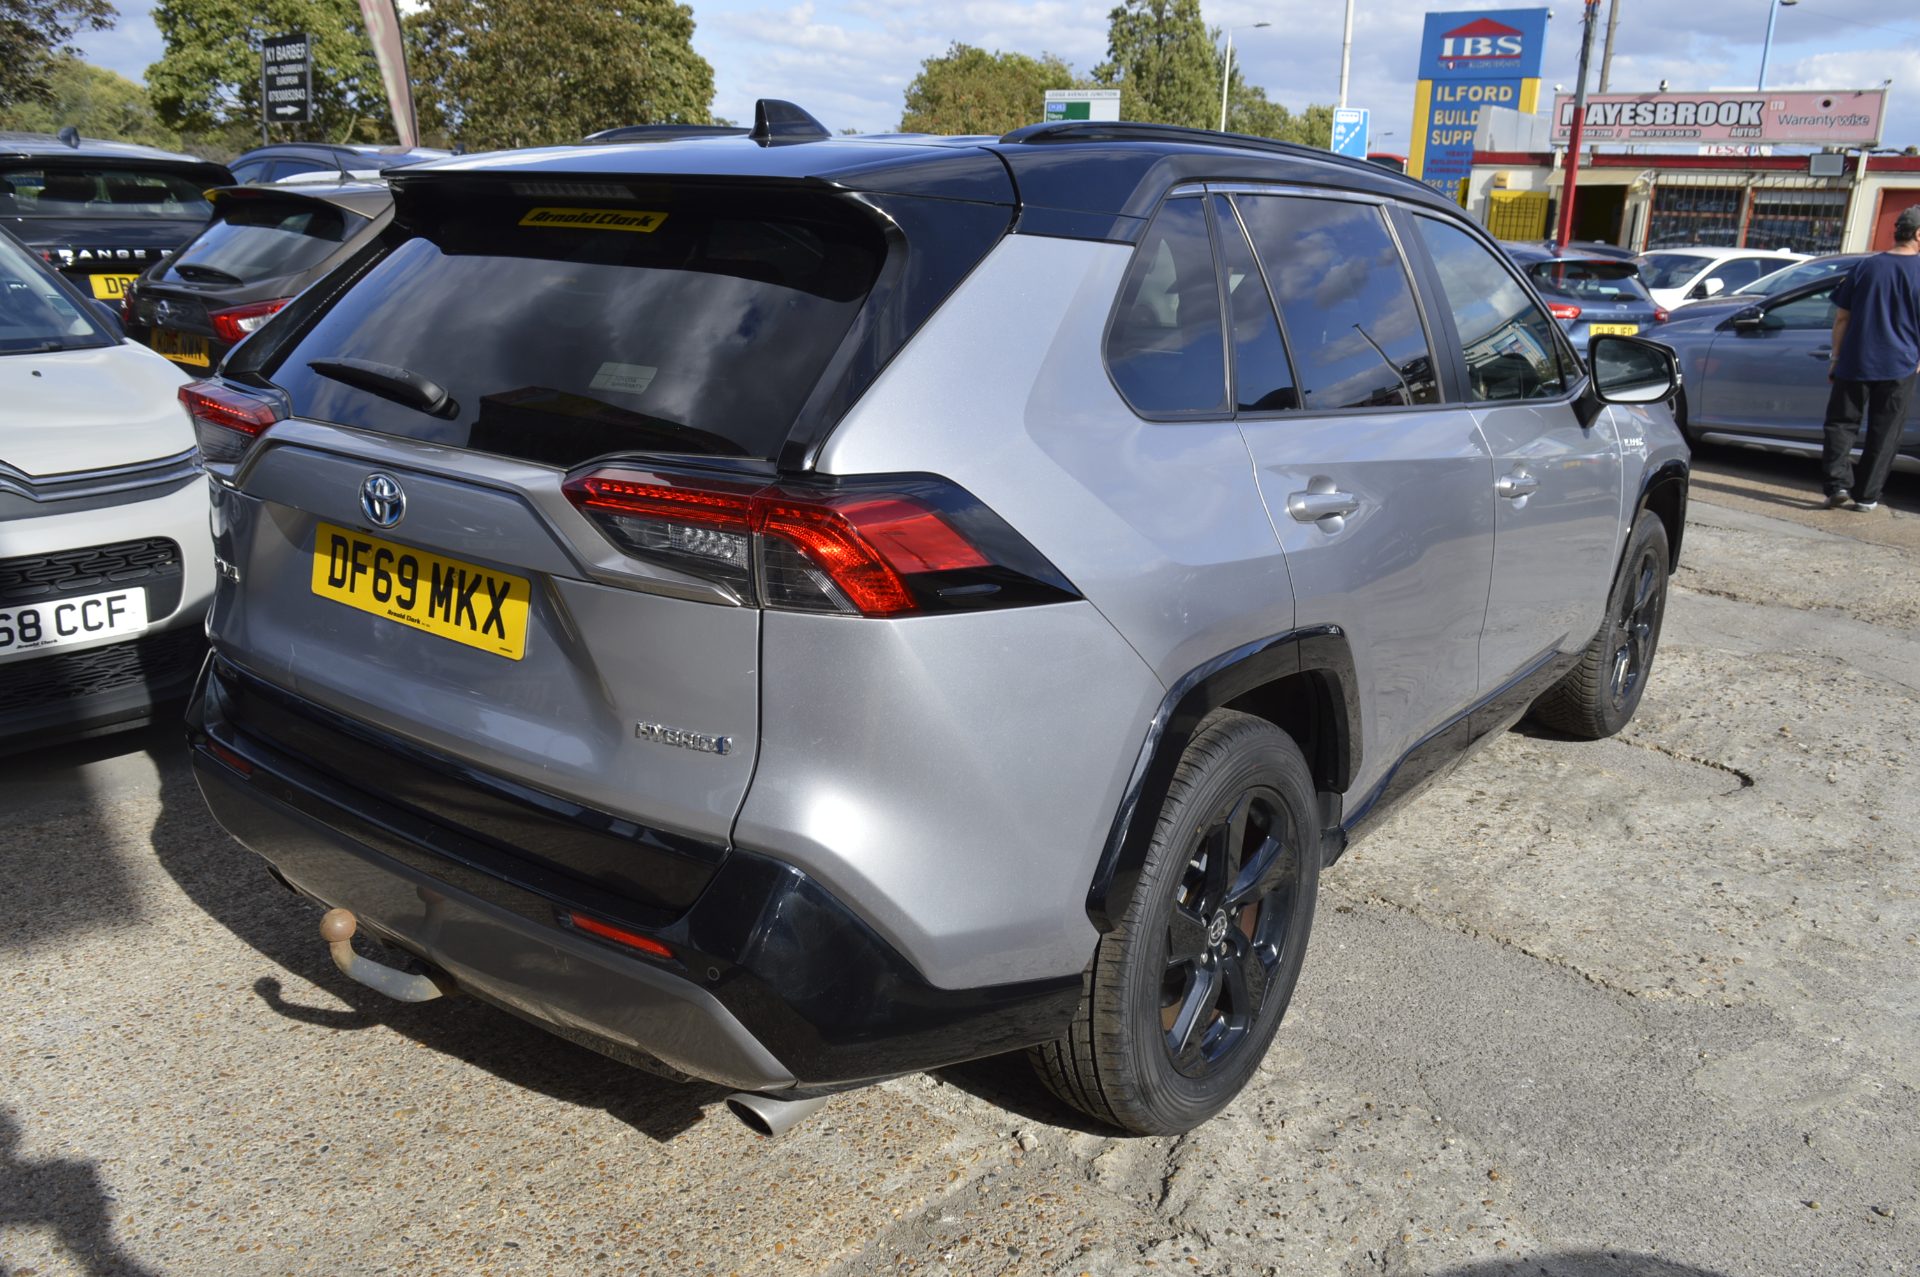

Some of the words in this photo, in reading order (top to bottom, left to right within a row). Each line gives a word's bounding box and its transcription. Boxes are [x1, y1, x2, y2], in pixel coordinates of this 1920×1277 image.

[276, 43, 306, 60] BARBER
[1442, 35, 1523, 57] IBS
[1436, 85, 1513, 102] ILFORD
[1729, 127, 1763, 138] AUTOS
[531, 212, 598, 223] Arnold
[595, 213, 654, 227] Clark
[58, 248, 147, 260] RANGE
[327, 532, 420, 612] DF69
[427, 561, 512, 641] MKX
[54, 594, 128, 637] CCF
[386, 609, 406, 620] Arnold
[406, 614, 421, 625] Clark
